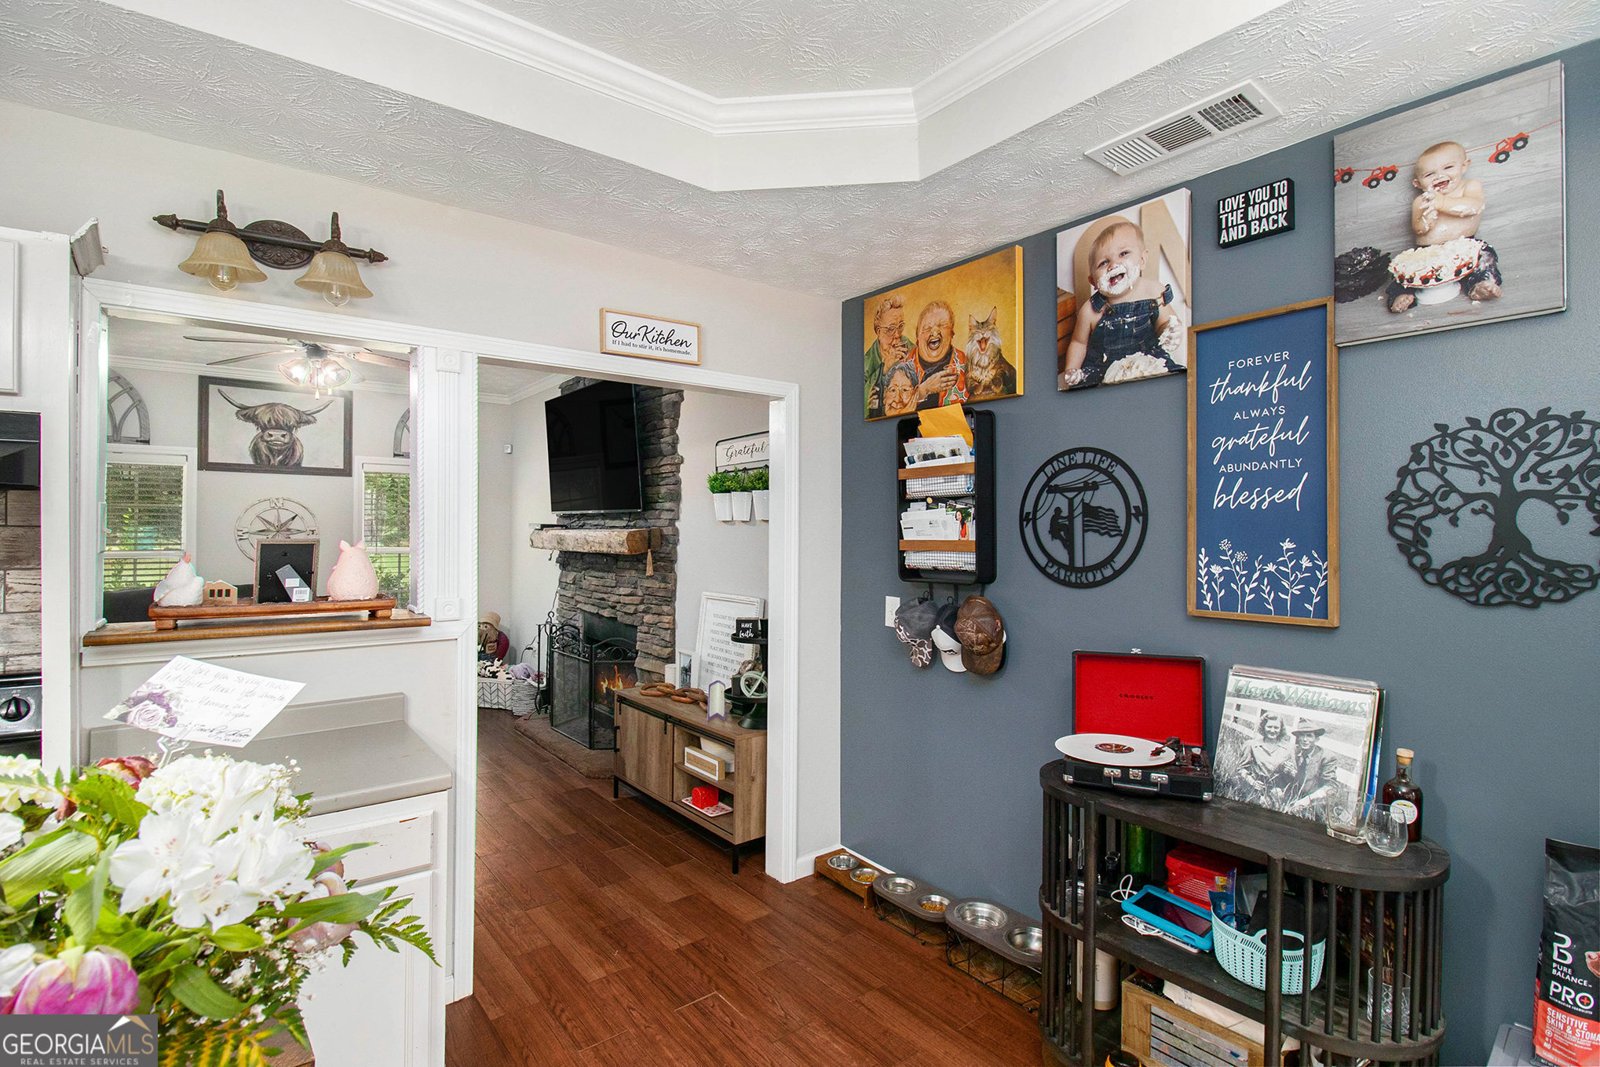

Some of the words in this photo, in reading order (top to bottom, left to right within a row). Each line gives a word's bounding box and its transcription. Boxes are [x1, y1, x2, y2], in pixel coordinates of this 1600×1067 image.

[1220, 193, 1246, 214] LOVE
[1248, 185, 1270, 205] YOU
[1273, 180, 1288, 197] TO
[1220, 209, 1245, 229] THE
[1248, 195, 1288, 221] MOON
[1220, 224, 1247, 244] AND
[1250, 212, 1288, 235] BACK
[611, 320, 640, 340] Our
[637, 325, 692, 348] Kitchen
[1228, 350, 1290, 370] FOREVER
[1208, 360, 1312, 404] thankful
[1233, 405, 1286, 421] ALWAYS
[725, 441, 768, 463] Grateful
[1211, 415, 1310, 465] grateful
[1042, 451, 1078, 478] LINE
[1083, 450, 1118, 474] LIFE
[1218, 458, 1303, 473] ABUNDANTLY
[1213, 472, 1309, 512] blessed
[1042, 559, 1119, 584] PARROTT
[1282, 686, 1367, 714] Williams
[1551, 968, 1589, 987] BALANCE
[1552, 962, 1573, 975] PURE
[1549, 980, 1595, 1010] PRO
[1546, 1007, 1589, 1031] SENSITIVE
[1546, 1015, 1564, 1030] SKIN
